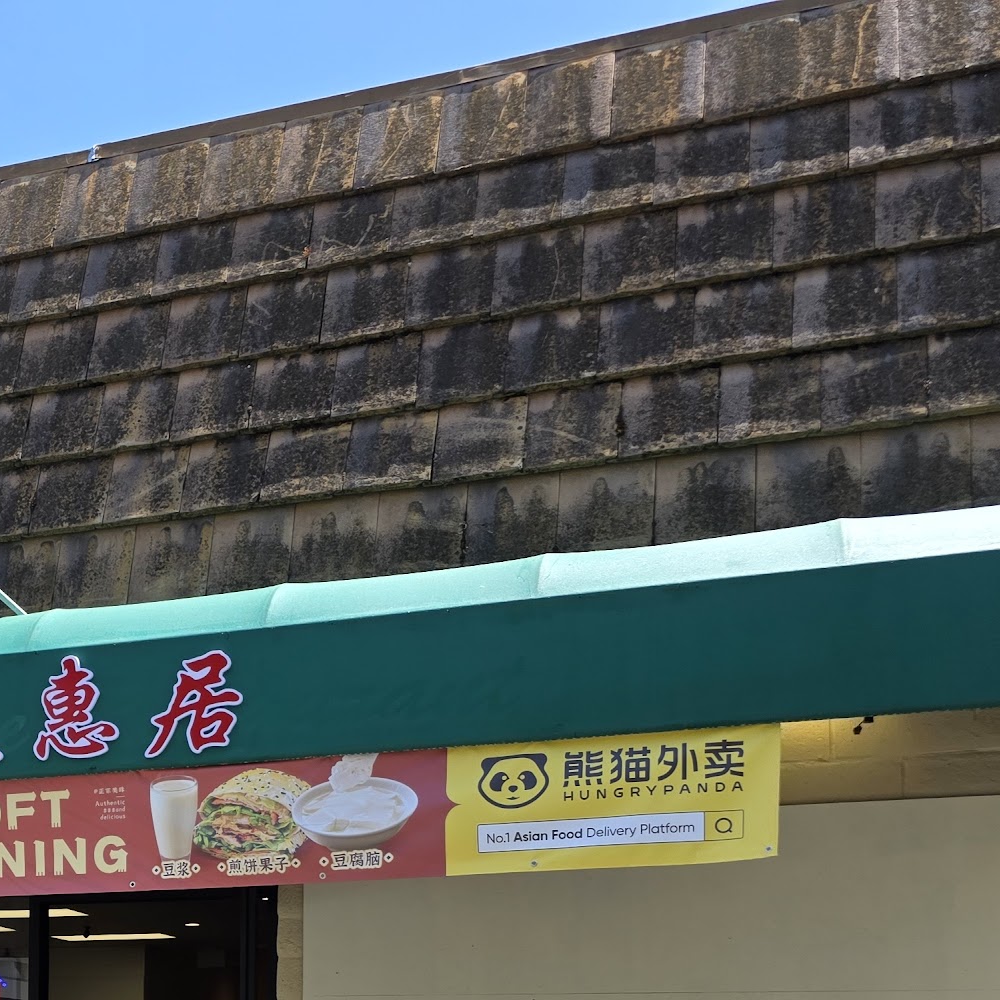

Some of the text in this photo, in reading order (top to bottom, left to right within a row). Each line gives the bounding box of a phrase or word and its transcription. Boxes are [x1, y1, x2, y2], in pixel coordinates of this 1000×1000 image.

[563, 740, 745, 787] 熊猫外卖
[563, 782, 744, 801] HUNGRYPANDA
[486, 822, 695, 844] No.1 Asian Food Delivery Platform
[162, 862, 190, 877] 豆浆
[228, 857, 289, 874] 煎饼果子
[332, 854, 382, 868] 豆腐脑
